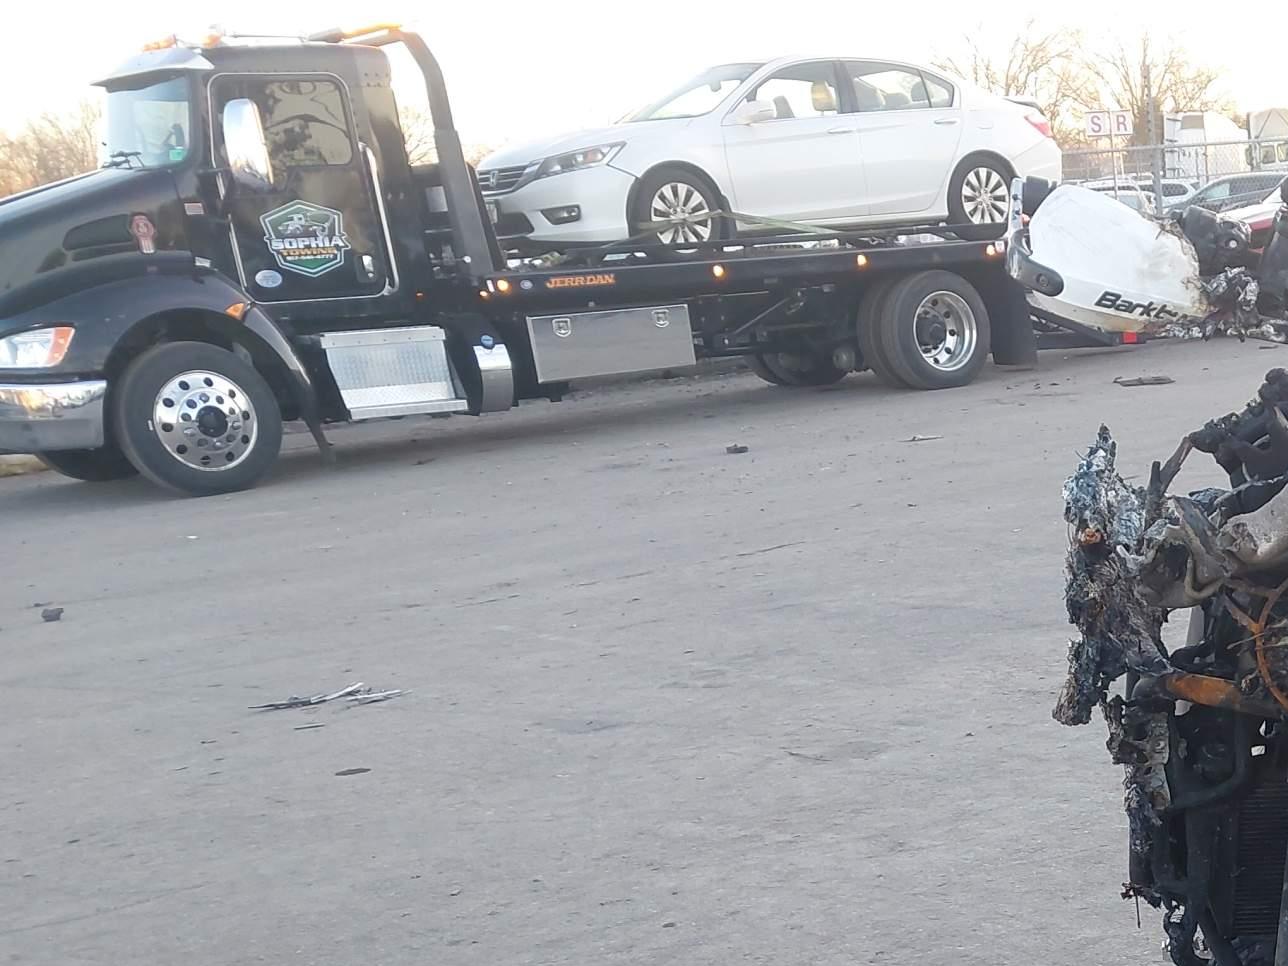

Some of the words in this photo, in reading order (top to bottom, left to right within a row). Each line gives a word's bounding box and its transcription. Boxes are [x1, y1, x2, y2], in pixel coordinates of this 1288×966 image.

[1091, 115, 1102, 133] S
[1116, 114, 1128, 132] R
[271, 236, 345, 250] SOPHIA
